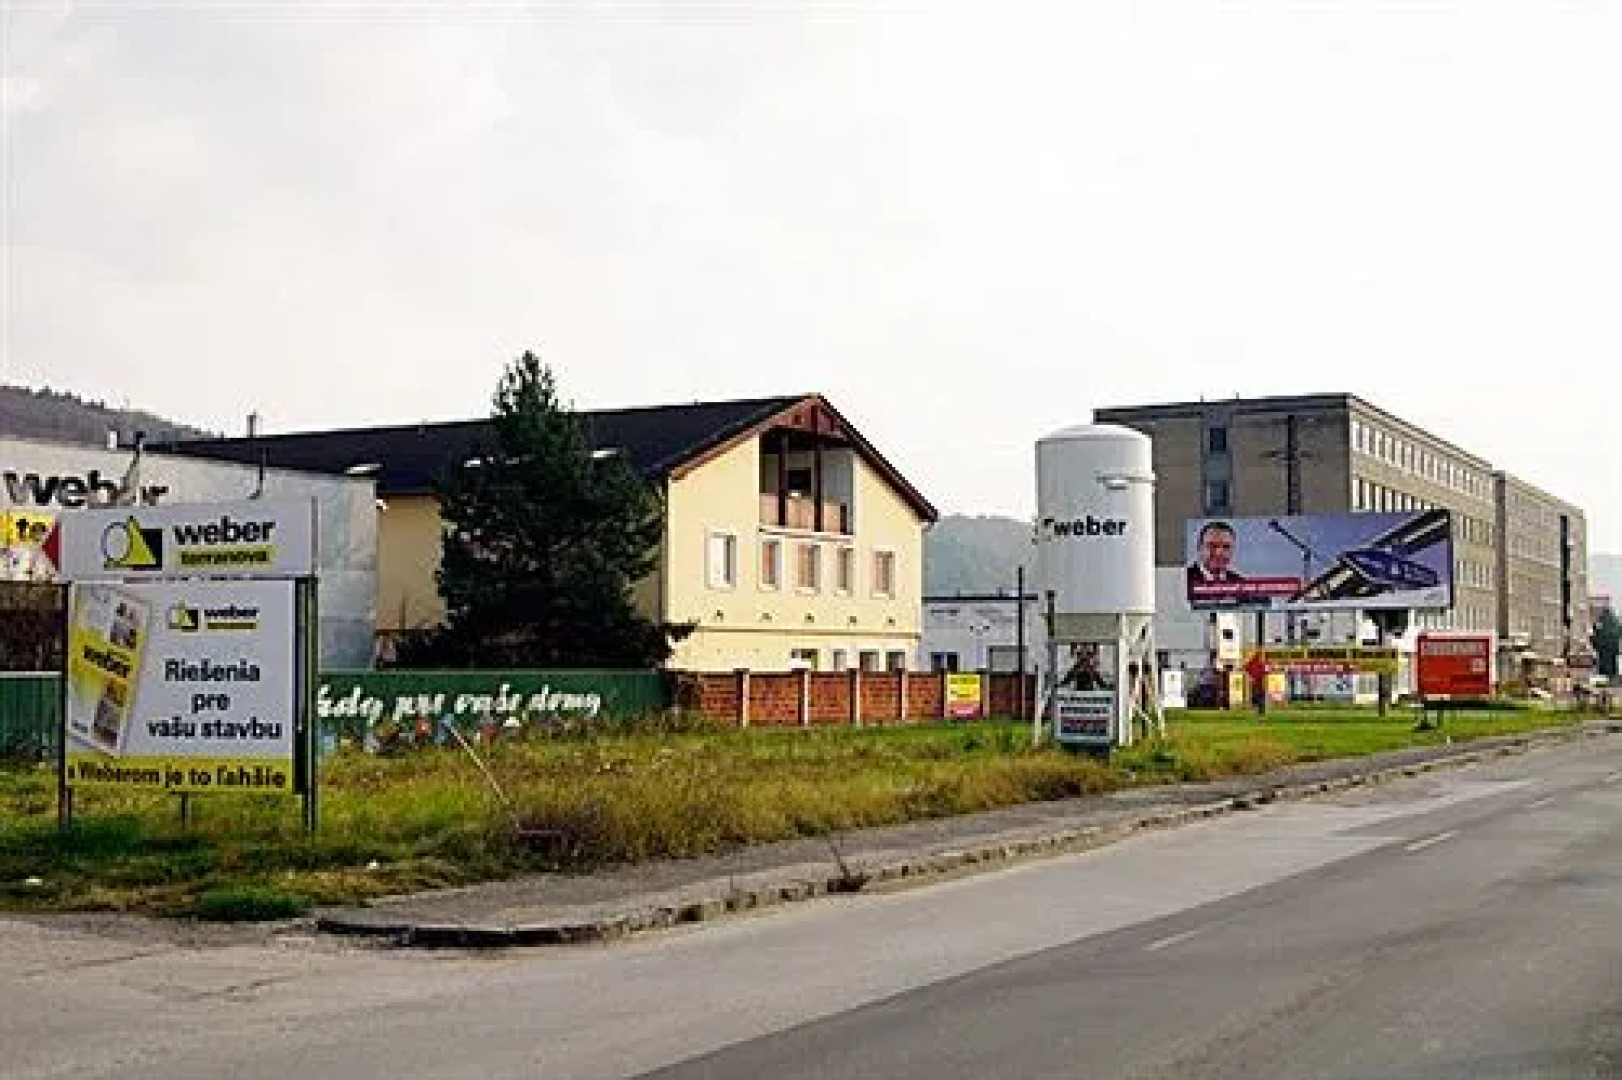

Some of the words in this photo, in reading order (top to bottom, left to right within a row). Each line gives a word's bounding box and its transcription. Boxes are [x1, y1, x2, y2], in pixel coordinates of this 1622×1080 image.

[2, 470, 169, 508] webr
[174, 516, 276, 545] weber
[1053, 515, 1127, 537] weber
[204, 605, 260, 618] weber
[165, 658, 261, 683] Riešenia
[191, 692, 231, 714] pre
[147, 716, 196, 738] vašu
[200, 716, 283, 739] stavbu
[164, 765, 184, 788] je
[188, 765, 212, 786] to
